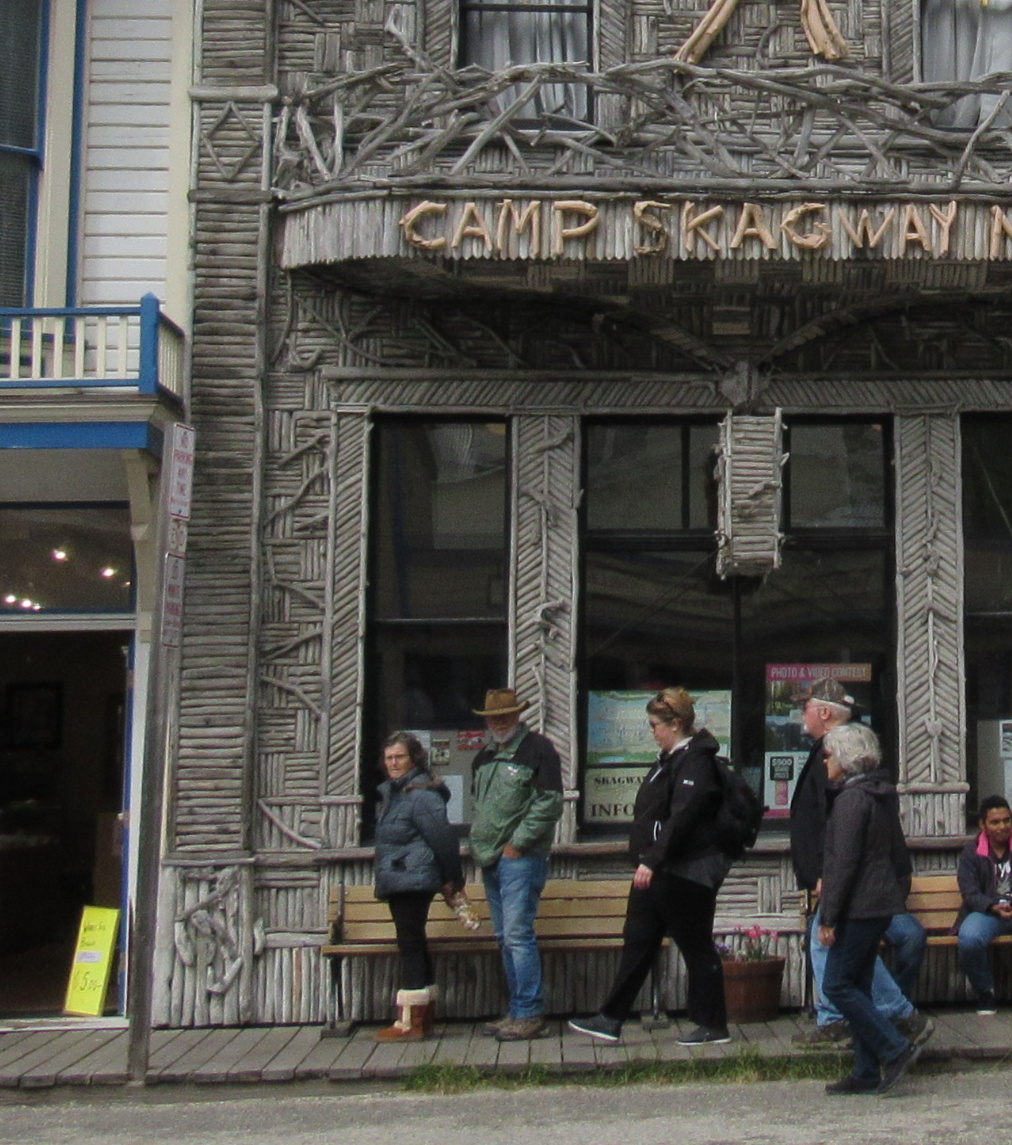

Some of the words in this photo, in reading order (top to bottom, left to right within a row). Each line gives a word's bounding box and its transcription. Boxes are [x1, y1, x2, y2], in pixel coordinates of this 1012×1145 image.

[400, 199, 598, 255] CAMP
[633, 200, 956, 256] SKAGWAY
[771, 667, 798, 678] PHOTO
[808, 667, 830, 678] VIDEO
